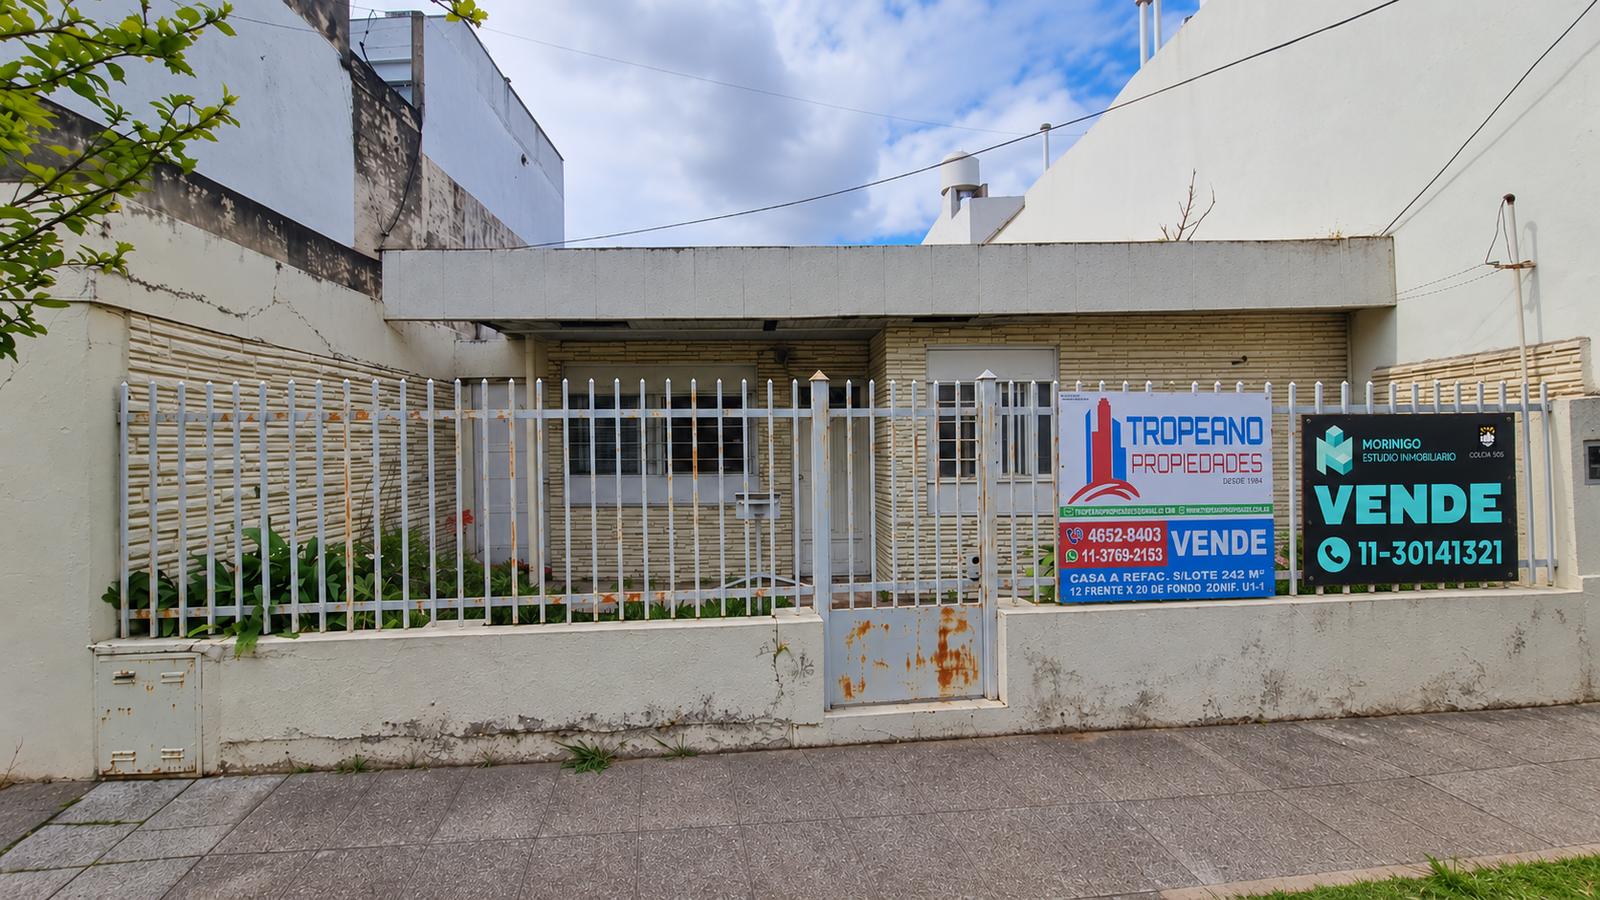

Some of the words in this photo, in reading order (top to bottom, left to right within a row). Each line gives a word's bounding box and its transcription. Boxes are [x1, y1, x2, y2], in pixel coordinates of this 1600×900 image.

[1126, 416, 1264, 446] TROPEANO
[1362, 438, 1422, 450] MORINIGO
[1132, 453, 1263, 474] PROPIEDADES
[1362, 453, 1399, 463] ESTUDIO
[1400, 452, 1457, 462] INMOBILIARIO
[1314, 482, 1503, 525] VENDE
[1088, 527, 1162, 543] 4652-8403
[1171, 528, 1268, 557] VENDE
[1081, 547, 1163, 563] 11-3769-2153
[1358, 540, 1503, 566] 11-30141321
[1070, 573, 1107, 583] CASA
[1109, 573, 1120, 582] A
[1123, 571, 1170, 582] REFAC.
[1173, 570, 1218, 581] S/LOTE
[1222, 569, 1245, 580] 242
[1070, 586, 1082, 596] 12
[1084, 585, 1124, 596] FRENTE
[1126, 585, 1133, 595] X
[1136, 584, 1148, 595] 20
[1151, 584, 1164, 594] DE
[1167, 583, 1202, 594] FONDO
